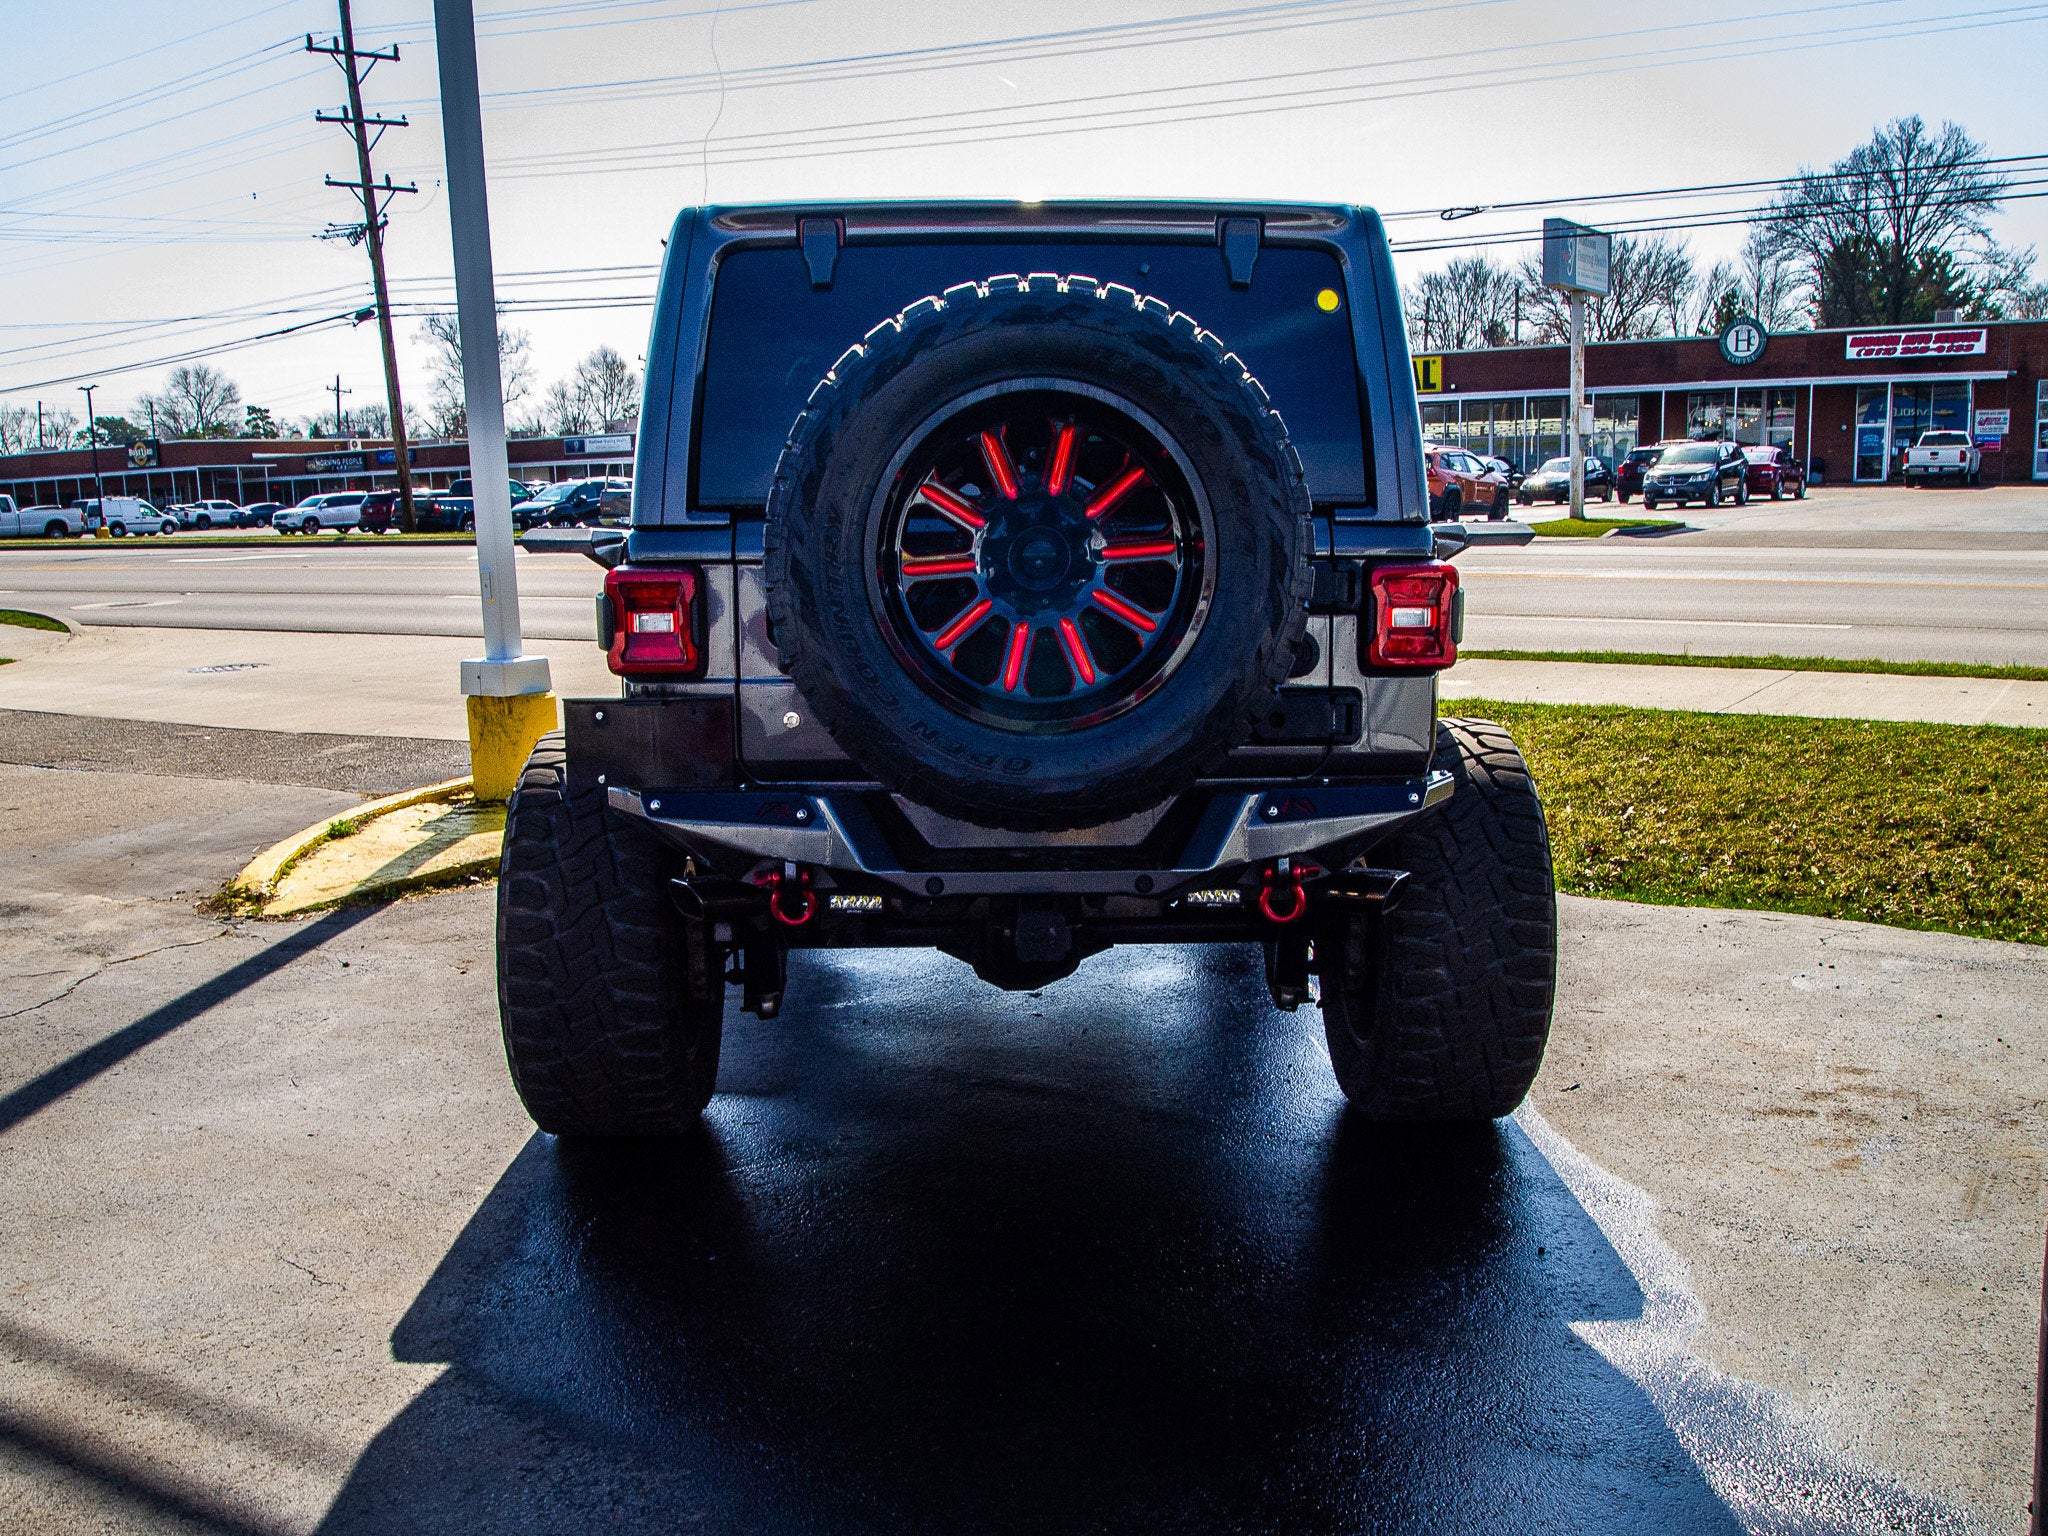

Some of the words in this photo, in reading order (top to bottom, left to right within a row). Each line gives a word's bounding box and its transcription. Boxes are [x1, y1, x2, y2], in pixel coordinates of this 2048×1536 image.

[1850, 335, 1901, 347] MADISON
[1902, 333, 1933, 346] AUTO
[1933, 331, 1982, 344] SERVICE
[819, 501, 902, 715] COUNTRY
[903, 715, 1031, 777] OPEN
